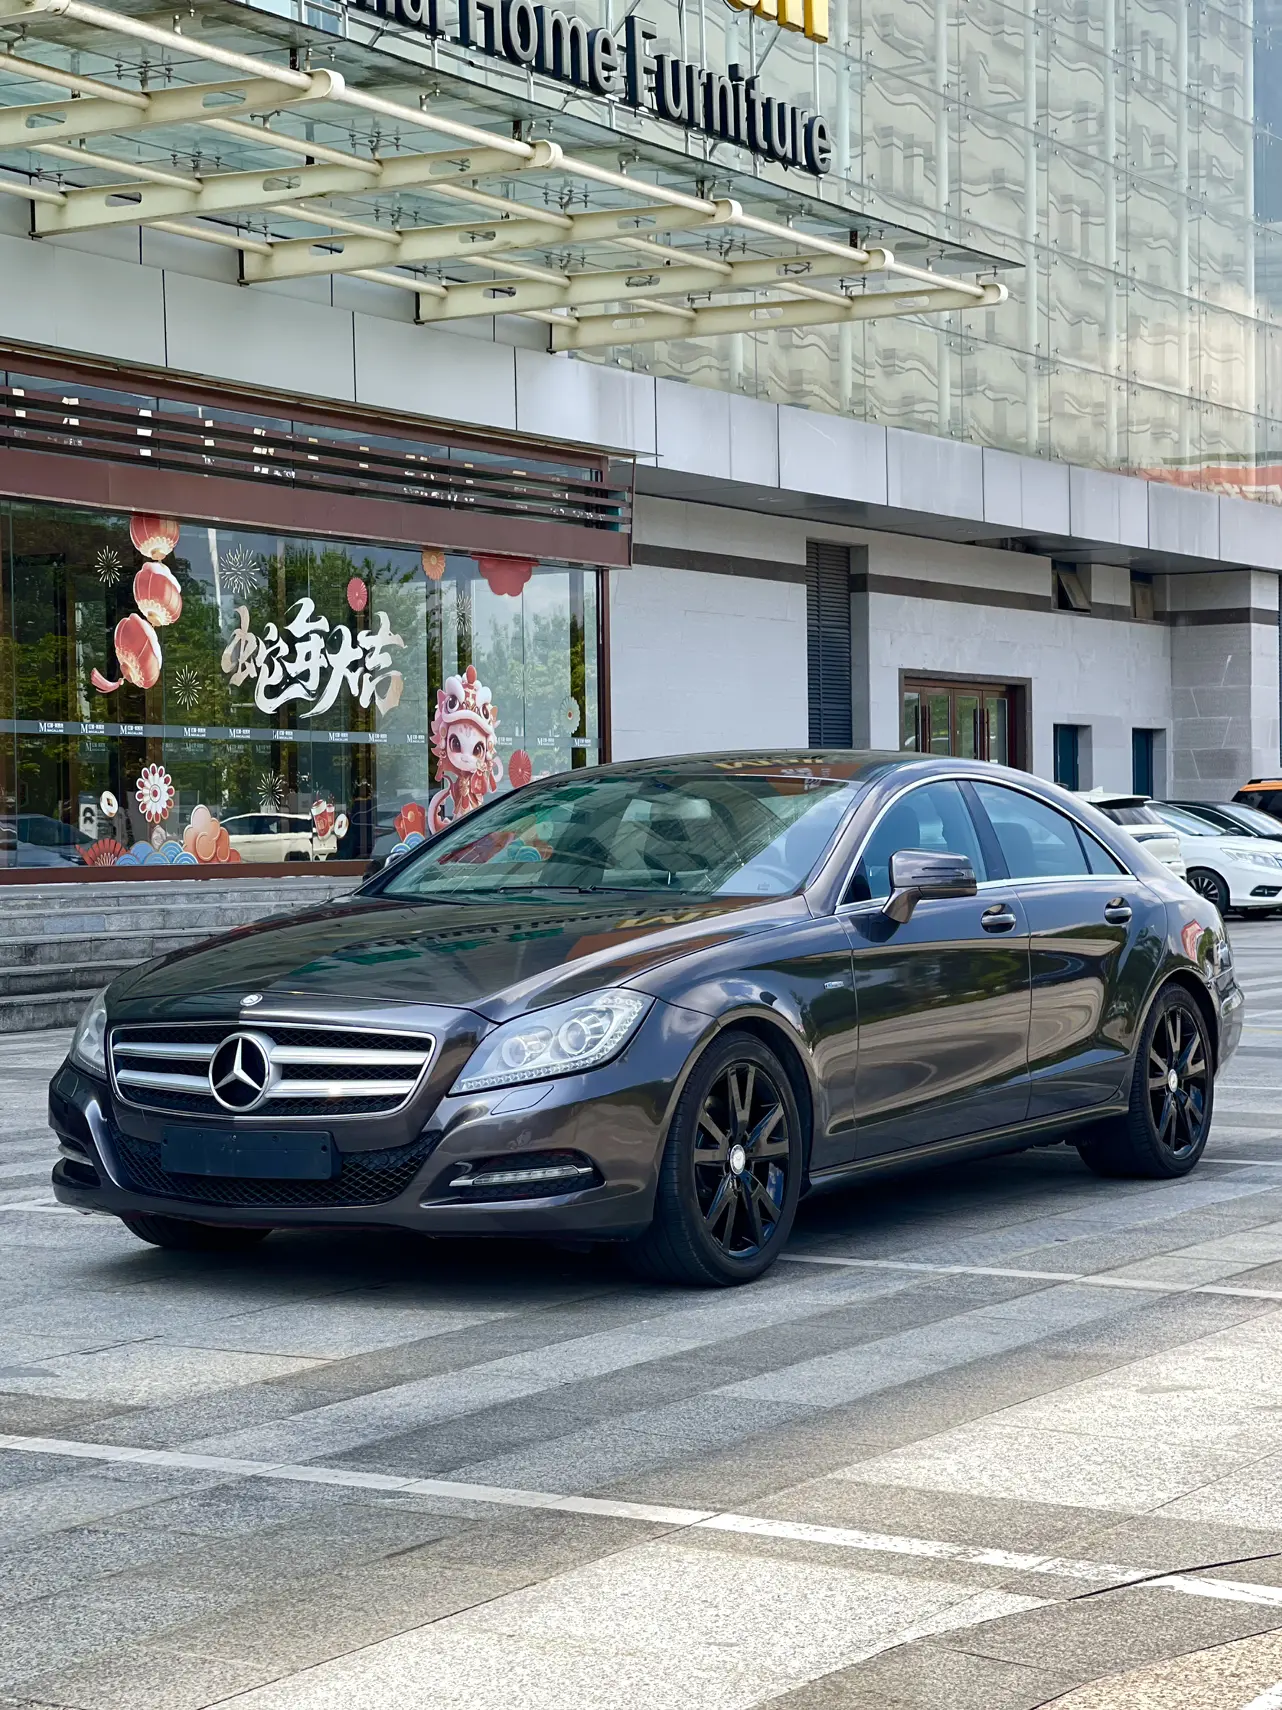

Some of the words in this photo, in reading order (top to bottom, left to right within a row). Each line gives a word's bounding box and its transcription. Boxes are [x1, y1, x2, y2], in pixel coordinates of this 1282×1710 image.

[625, 15, 832, 175] Furniture
[221, 597, 406, 718] 蛇年大吉
